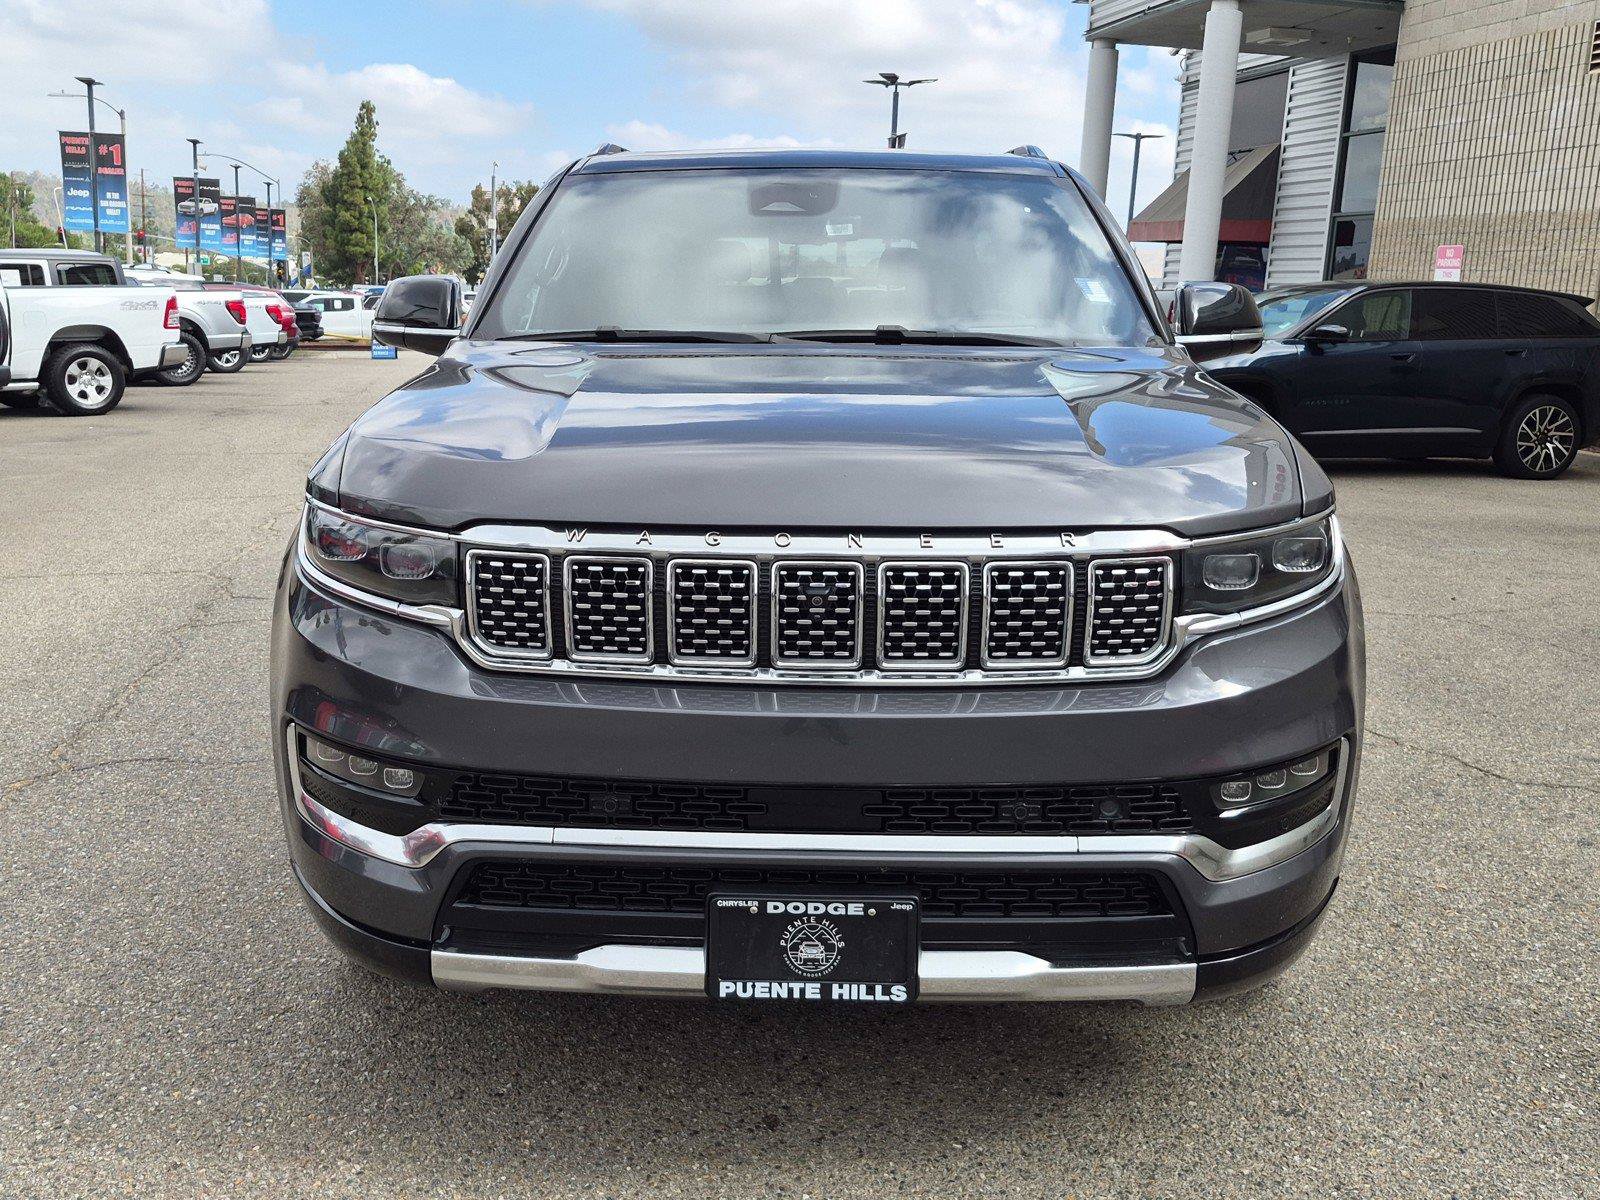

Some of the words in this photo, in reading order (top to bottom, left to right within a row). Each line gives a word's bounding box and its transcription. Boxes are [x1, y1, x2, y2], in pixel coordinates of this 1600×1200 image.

[65, 145, 86, 155] HILLS
[98, 144, 122, 166] #1
[67, 187, 90, 198] Jeep
[1445, 248, 1455, 258] NO
[1436, 258, 1461, 267] PARKING
[565, 528, 1076, 549] WAGONEER
[766, 901, 865, 915] DODGE
[890, 902, 913, 911] Jeep
[780, 916, 816, 946] PUENTE
[822, 918, 846, 948] HILLS
[719, 982, 821, 999] PUENTE
[832, 983, 907, 1001] HILLS
